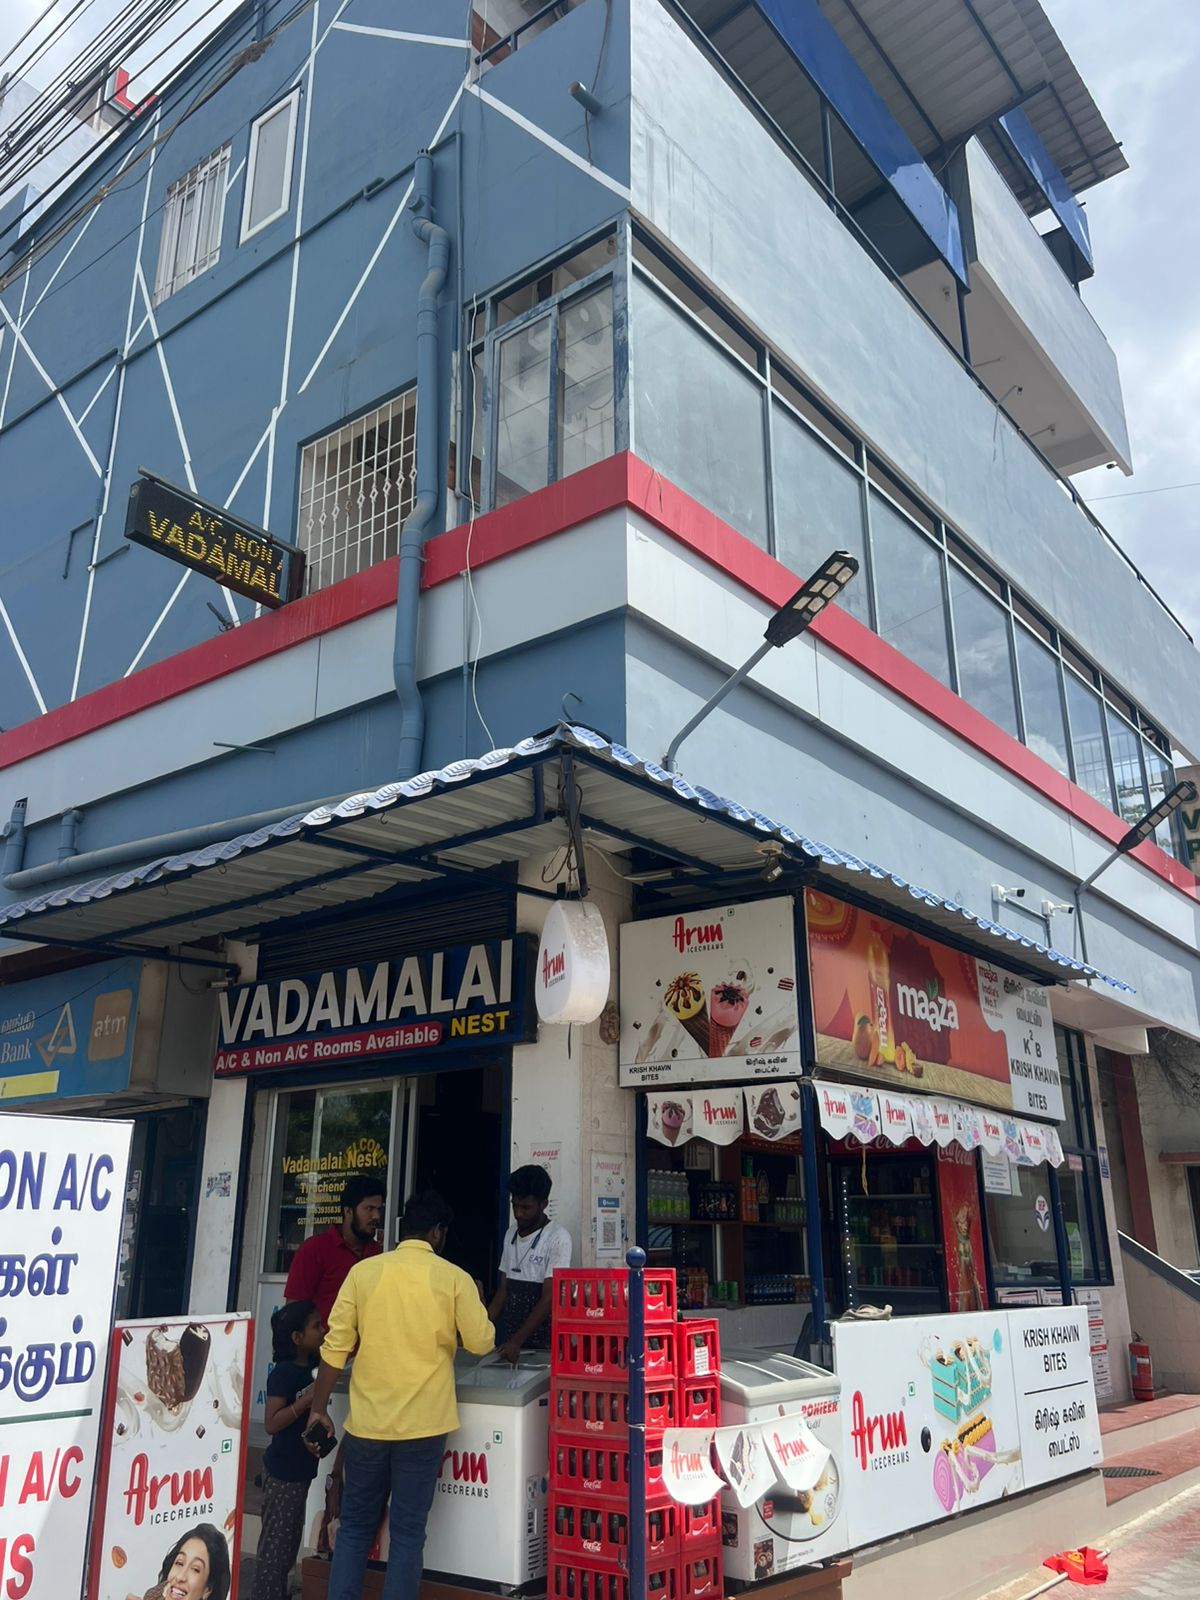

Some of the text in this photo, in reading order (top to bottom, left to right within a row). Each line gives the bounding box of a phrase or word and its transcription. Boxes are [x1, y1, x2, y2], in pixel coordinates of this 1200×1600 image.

[148, 509, 280, 599] VADAMAL
[233, 532, 273, 565] NON
[673, 916, 723, 953] Arun
[687, 943, 724, 953] ICECREAMS
[541, 948, 565, 989] Arun
[218, 938, 513, 1045] VADAMALAI
[897, 982, 959, 1032] maaza
[94, 1014, 126, 1038] atm
[450, 1010, 511, 1038] NEST
[1, 1038, 32, 1064] Bank
[216, 1027, 440, 1071] A/C & Non A/C Rooms Available
[629, 1063, 671, 1075] KRISH KHAVIN
[641, 1073, 659, 1082] BITES
[1010, 1058, 1060, 1086] KRISH KHAVIN
[703, 1099, 737, 1125] Arun
[823, 1090, 847, 1115] Arun
[885, 1099, 906, 1123] Arun
[1027, 1091, 1048, 1111] BITES
[934, 1104, 949, 1126] Arun
[282, 1150, 379, 1174] Vadamalai Nest
[52, 1152, 114, 1211] A/C
[1023, 1324, 1080, 1348] KRISH KHAVIN
[1043, 1352, 1067, 1373] BITES
[850, 1390, 908, 1472] Arun
[671, 1441, 703, 1480] Arun
[773, 1432, 810, 1467] Arun
[871, 1451, 911, 1472] ICECREAMS
[18, 1445, 84, 1505] A/C
[436, 1449, 488, 1485] run
[124, 1453, 214, 1526] Arun
[437, 1482, 489, 1499] ICECREAMS
[150, 1502, 214, 1526] ICECREAMS
